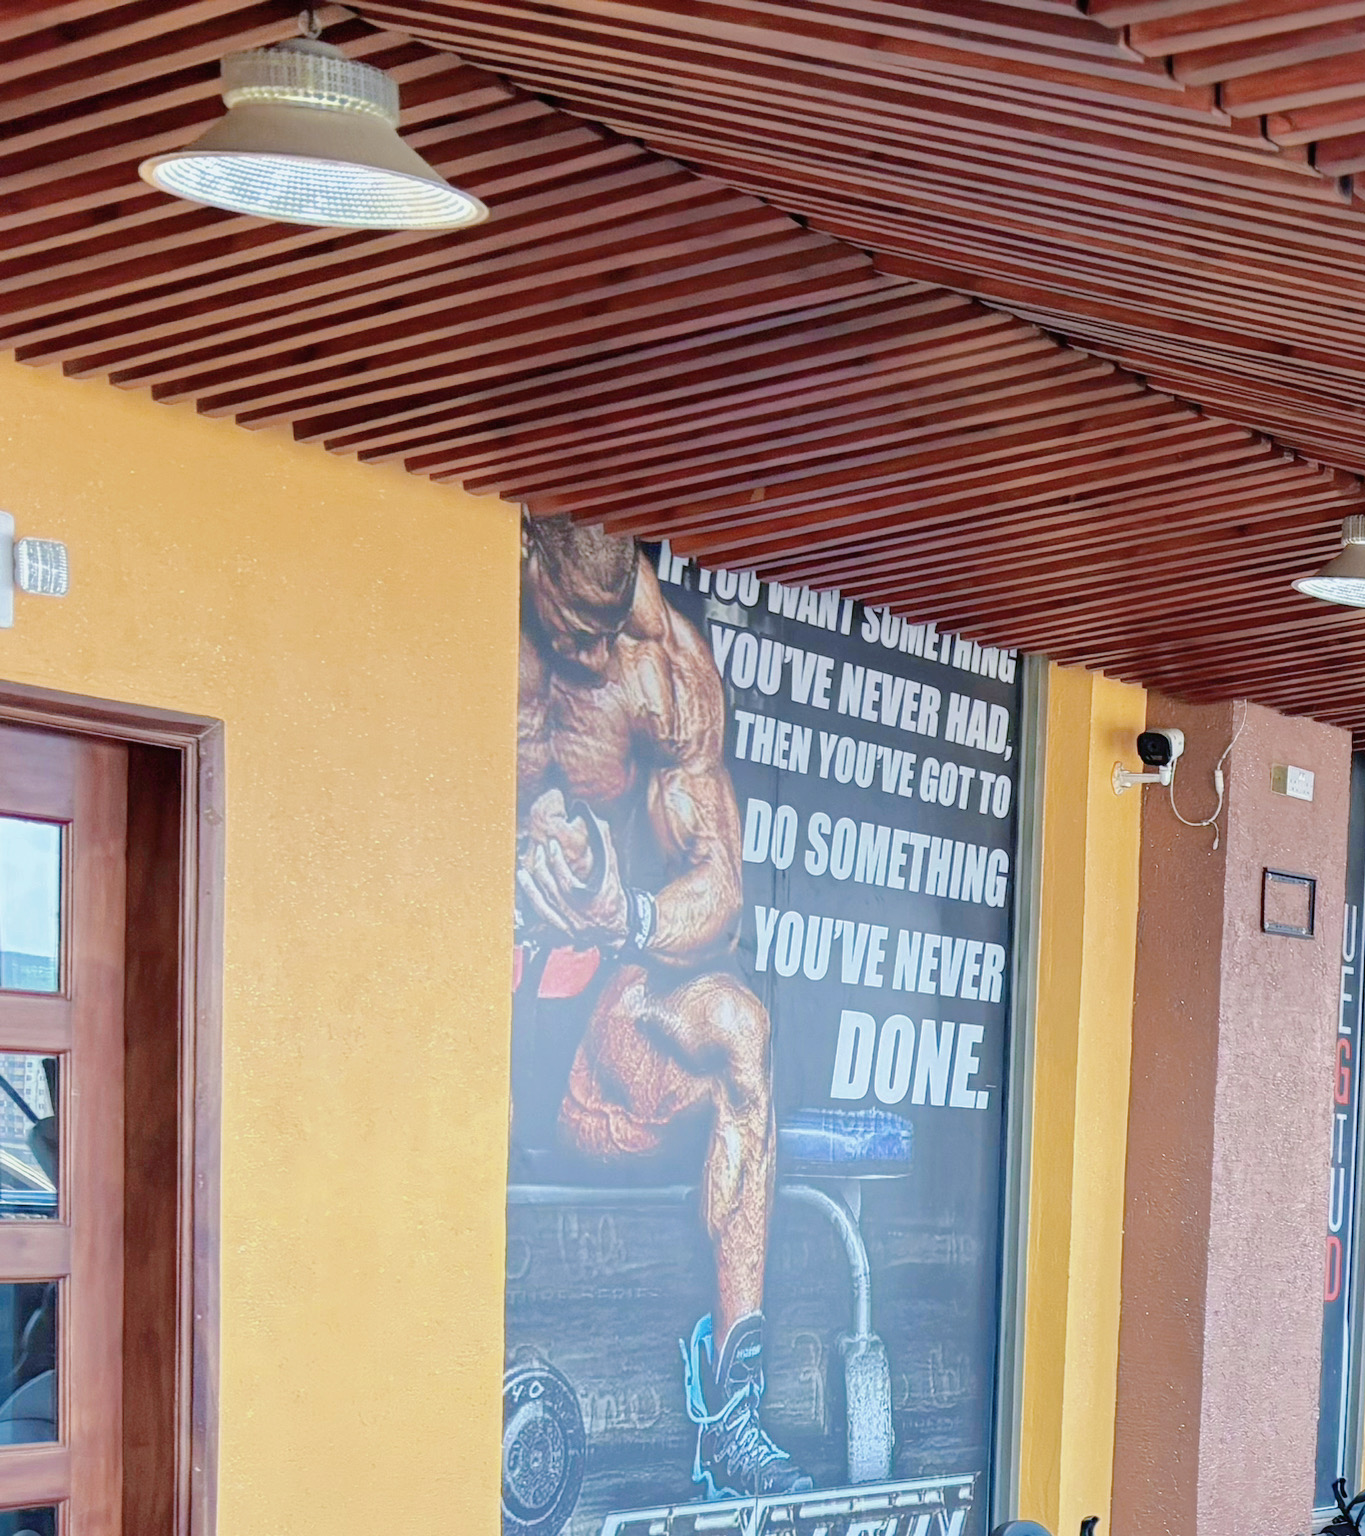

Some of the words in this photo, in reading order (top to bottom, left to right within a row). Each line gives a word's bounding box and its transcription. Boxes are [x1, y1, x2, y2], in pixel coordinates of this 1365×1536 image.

[710, 624, 835, 711] YOU'VE
[837, 661, 942, 738] NEVER
[944, 691, 1013, 761] HAD,
[734, 709, 813, 775] THEN
[819, 730, 917, 798] YOU'VE
[919, 757, 976, 811] GOT
[979, 770, 1012, 820] TO
[742, 798, 798, 871] DO
[804, 812, 1010, 909] SOMETHING
[754, 904, 890, 989] YOU'VE
[892, 928, 1006, 1004] NEVER
[830, 1009, 990, 1110] DONE.
